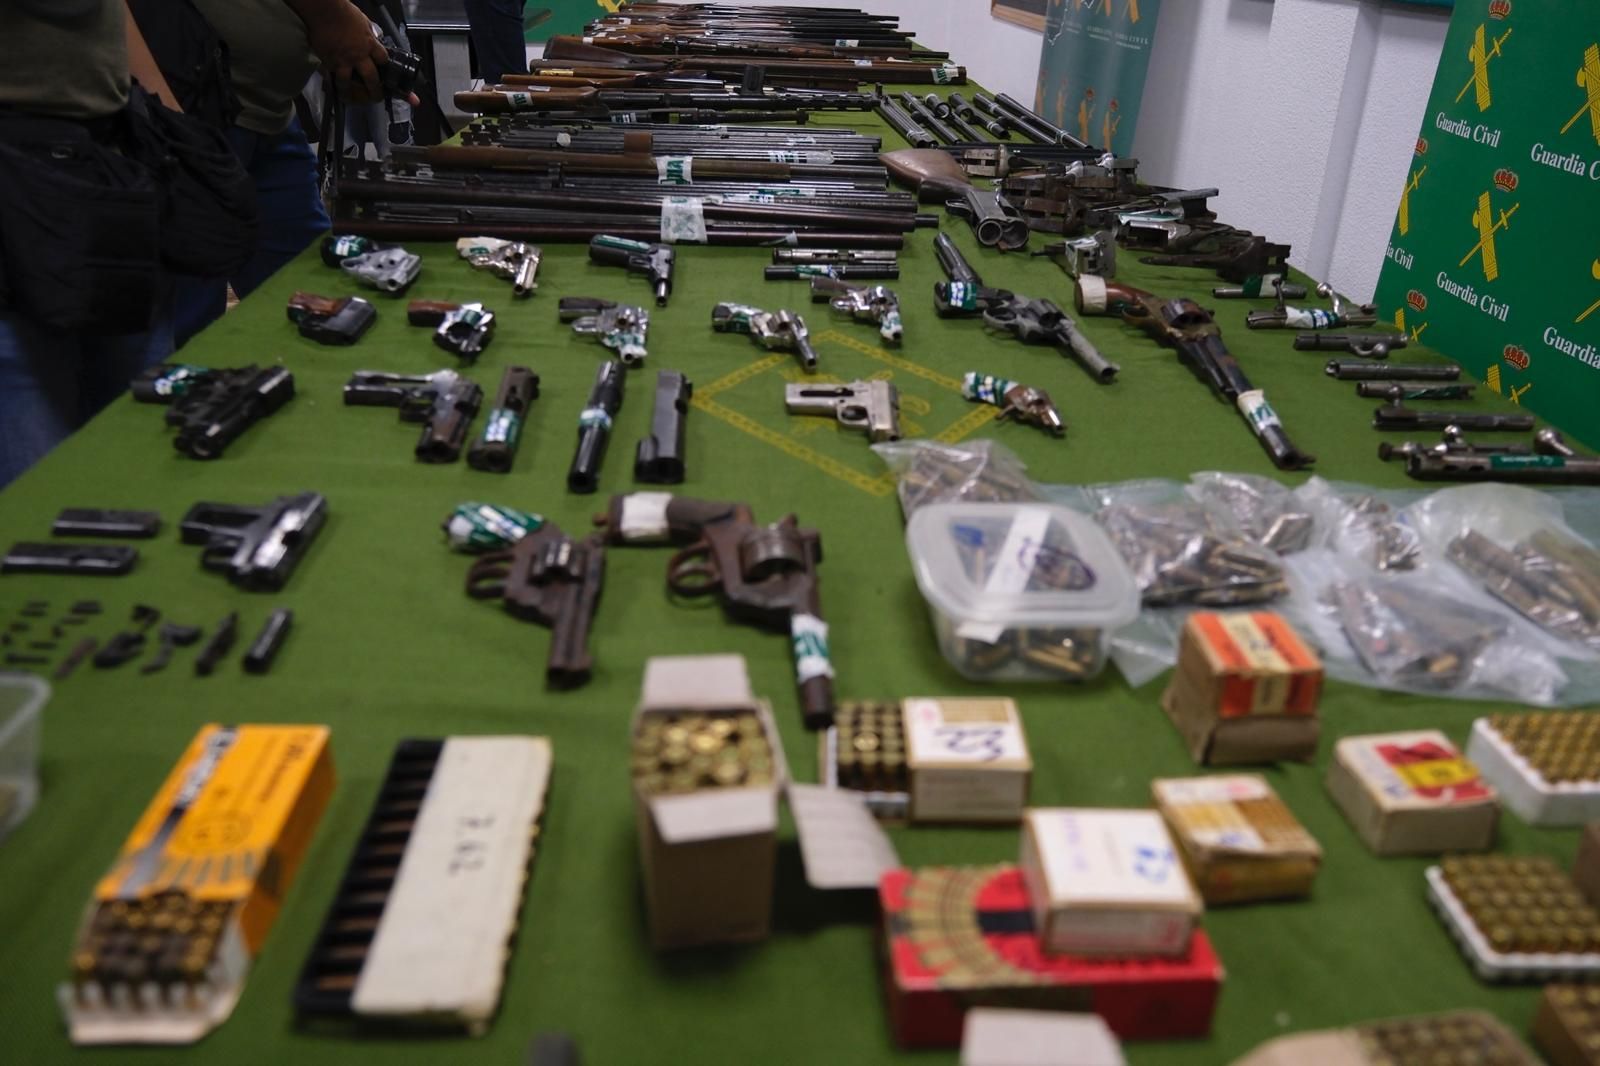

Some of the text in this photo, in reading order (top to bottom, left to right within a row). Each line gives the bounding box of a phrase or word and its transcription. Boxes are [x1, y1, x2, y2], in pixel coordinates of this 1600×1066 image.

[1436, 112, 1500, 148] Guardia Civil
[1530, 143, 1586, 177] Guardia
[1394, 247, 1414, 270] Civil
[1436, 271, 1510, 322] Guardia Civil
[1543, 326, 1600, 370] Guardia
